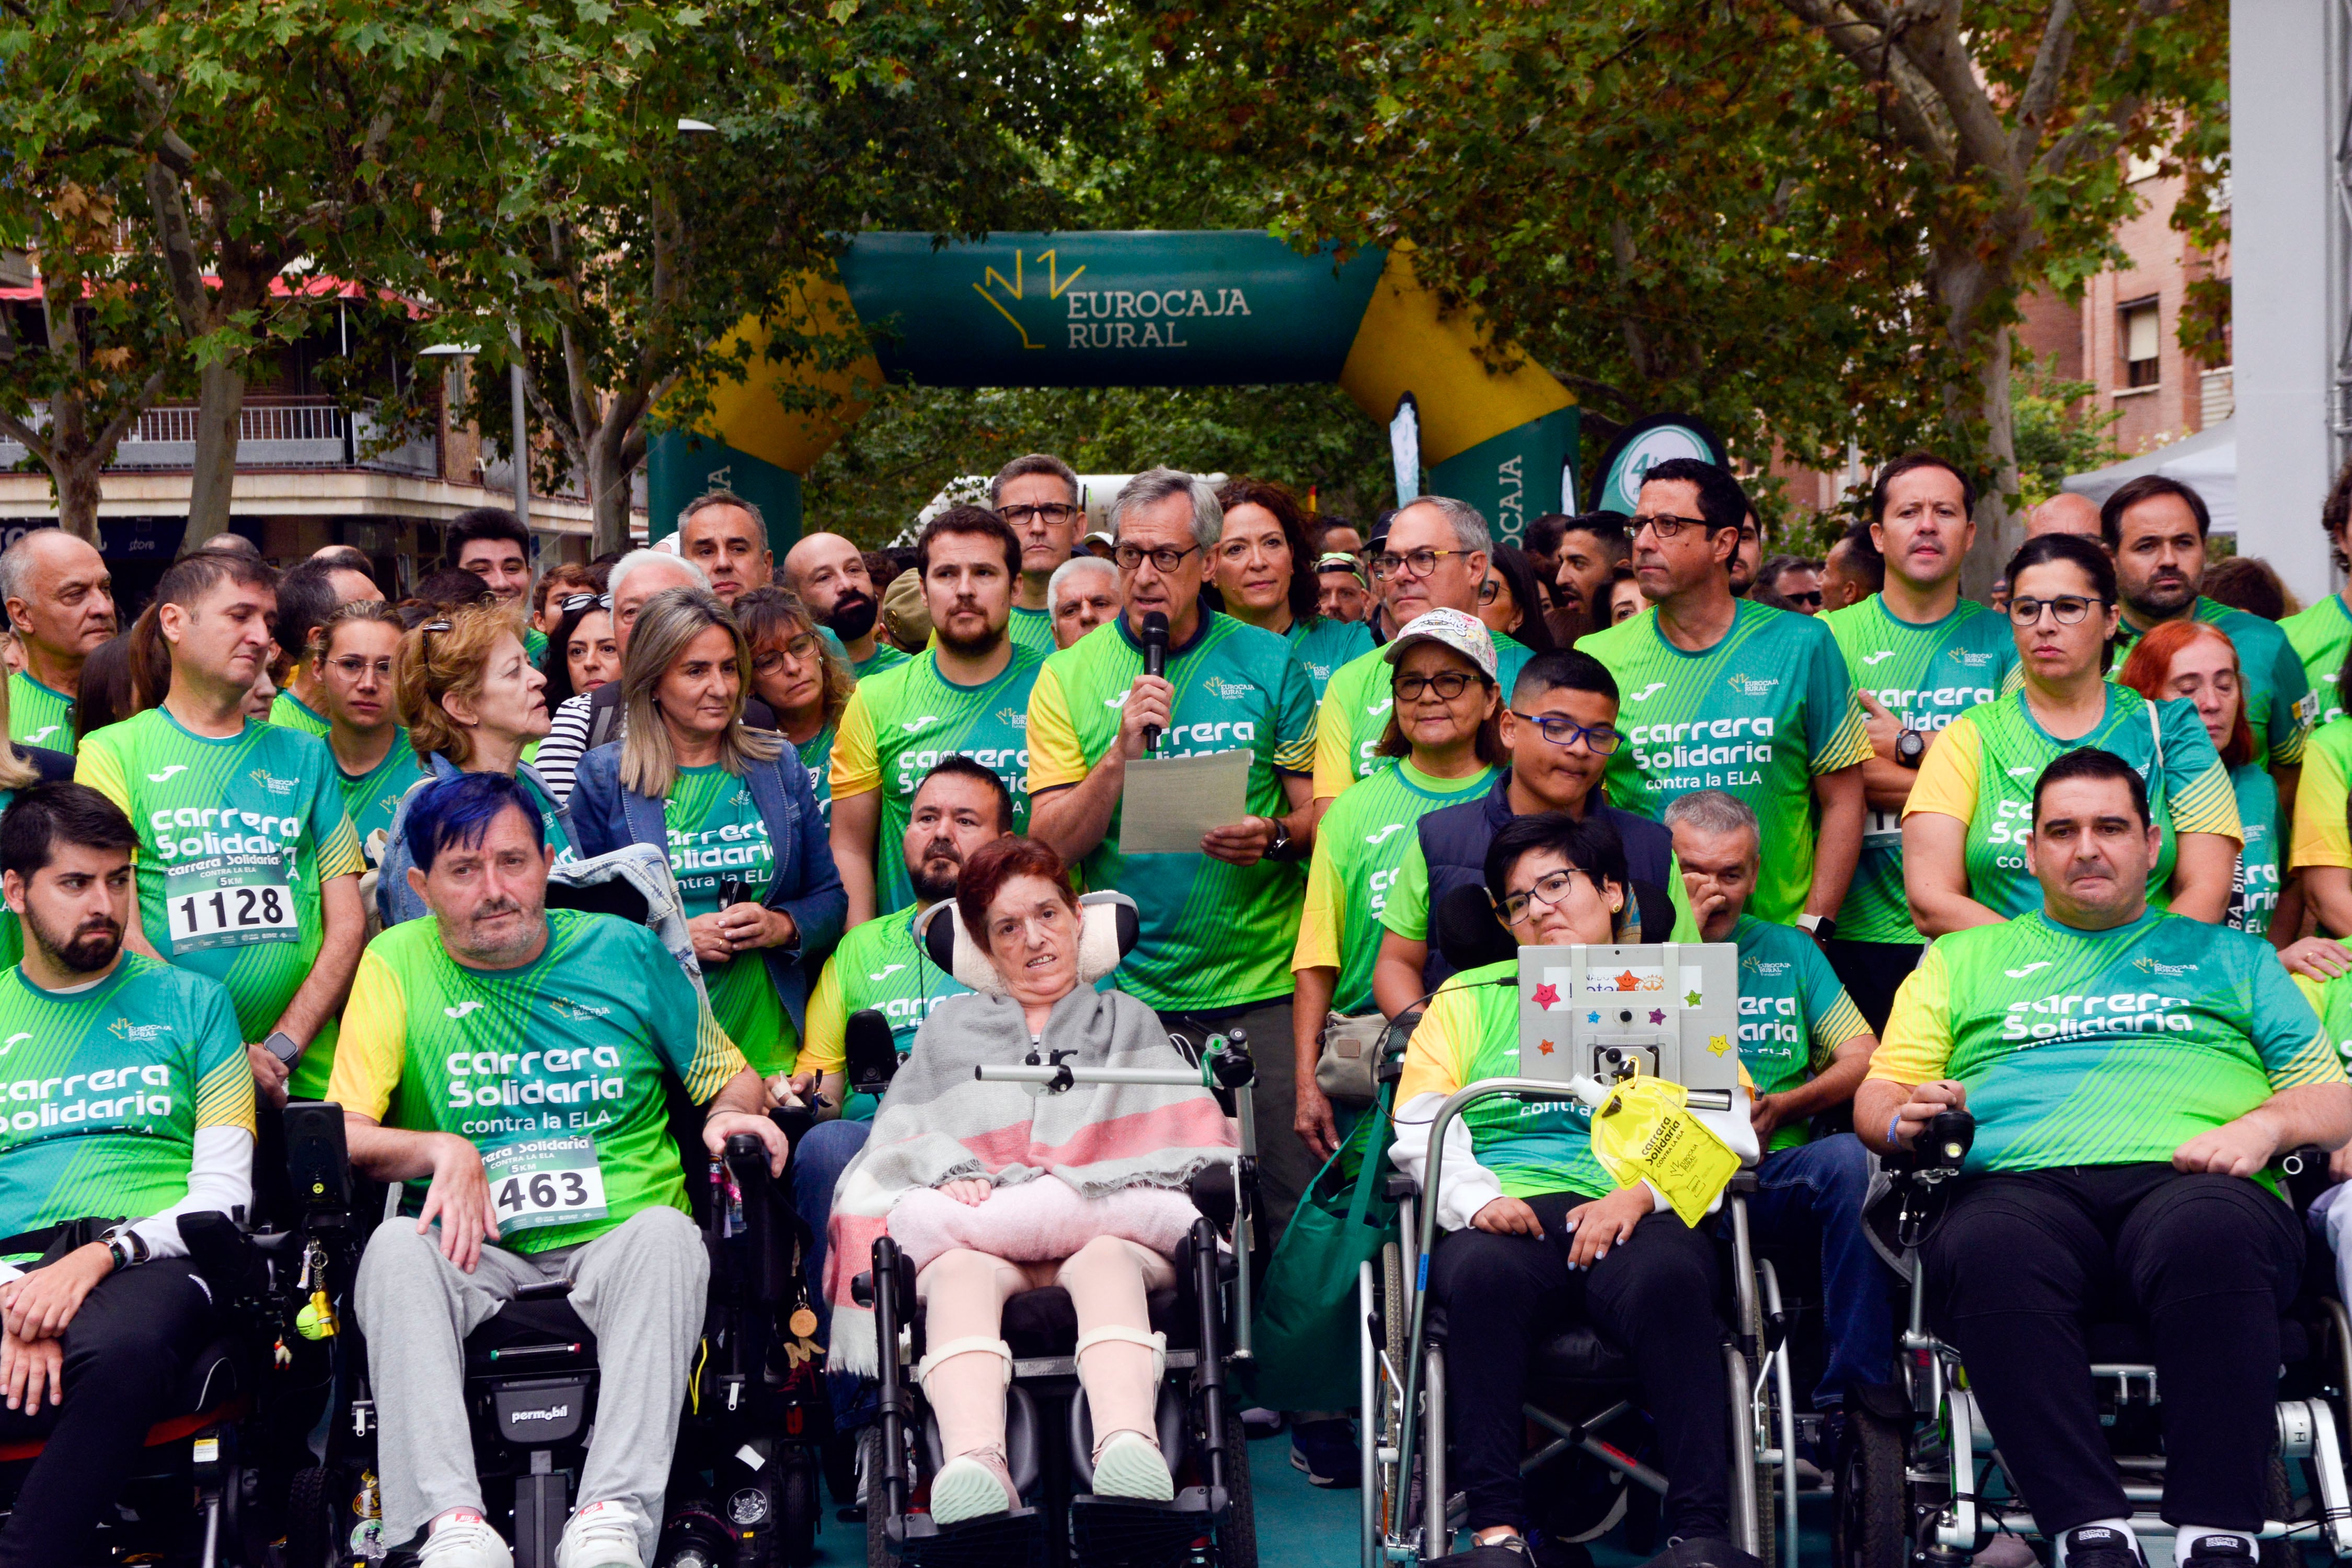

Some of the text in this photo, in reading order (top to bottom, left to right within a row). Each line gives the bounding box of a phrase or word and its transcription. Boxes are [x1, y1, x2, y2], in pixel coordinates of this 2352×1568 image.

[1067, 289, 1252, 319] EUROCAJA
[1067, 321, 1187, 349] RURAL
[128, 537, 155, 552] store
[1745, 679, 1779, 687] EUROCAJA
[1629, 717, 1774, 745] carrera
[1631, 741, 1772, 770] Solidaria
[1645, 770, 1762, 791] contra la ELA
[151, 808, 301, 838] carrera
[167, 854, 280, 877] carrera Solidaria
[200, 868, 232, 879] CONTRA
[180, 887, 284, 933] 1128
[128, 1024, 172, 1032] EUROCAJA
[2002, 1009, 2193, 1041] Solidaria
[446, 1046, 620, 1076] carrera
[447, 1074, 624, 1108] Solidaria
[462, 1109, 612, 1134] contra la ELA
[518, 1137, 590, 1154] Solidaria
[1641, 1116, 1671, 1156] carrera
[1645, 1120, 1681, 1166] Solidaria
[1656, 1131, 1685, 1168] CONTRA LA ELA
[1679, 1144, 1699, 1169] EUROCAJA
[490, 1156, 524, 1170] CONTRA
[1683, 1155, 1697, 1171] RURAL
[498, 1172, 589, 1213] 463
[511, 1404, 569, 1424] permobil
[583, 1503, 599, 1514] NIKE
